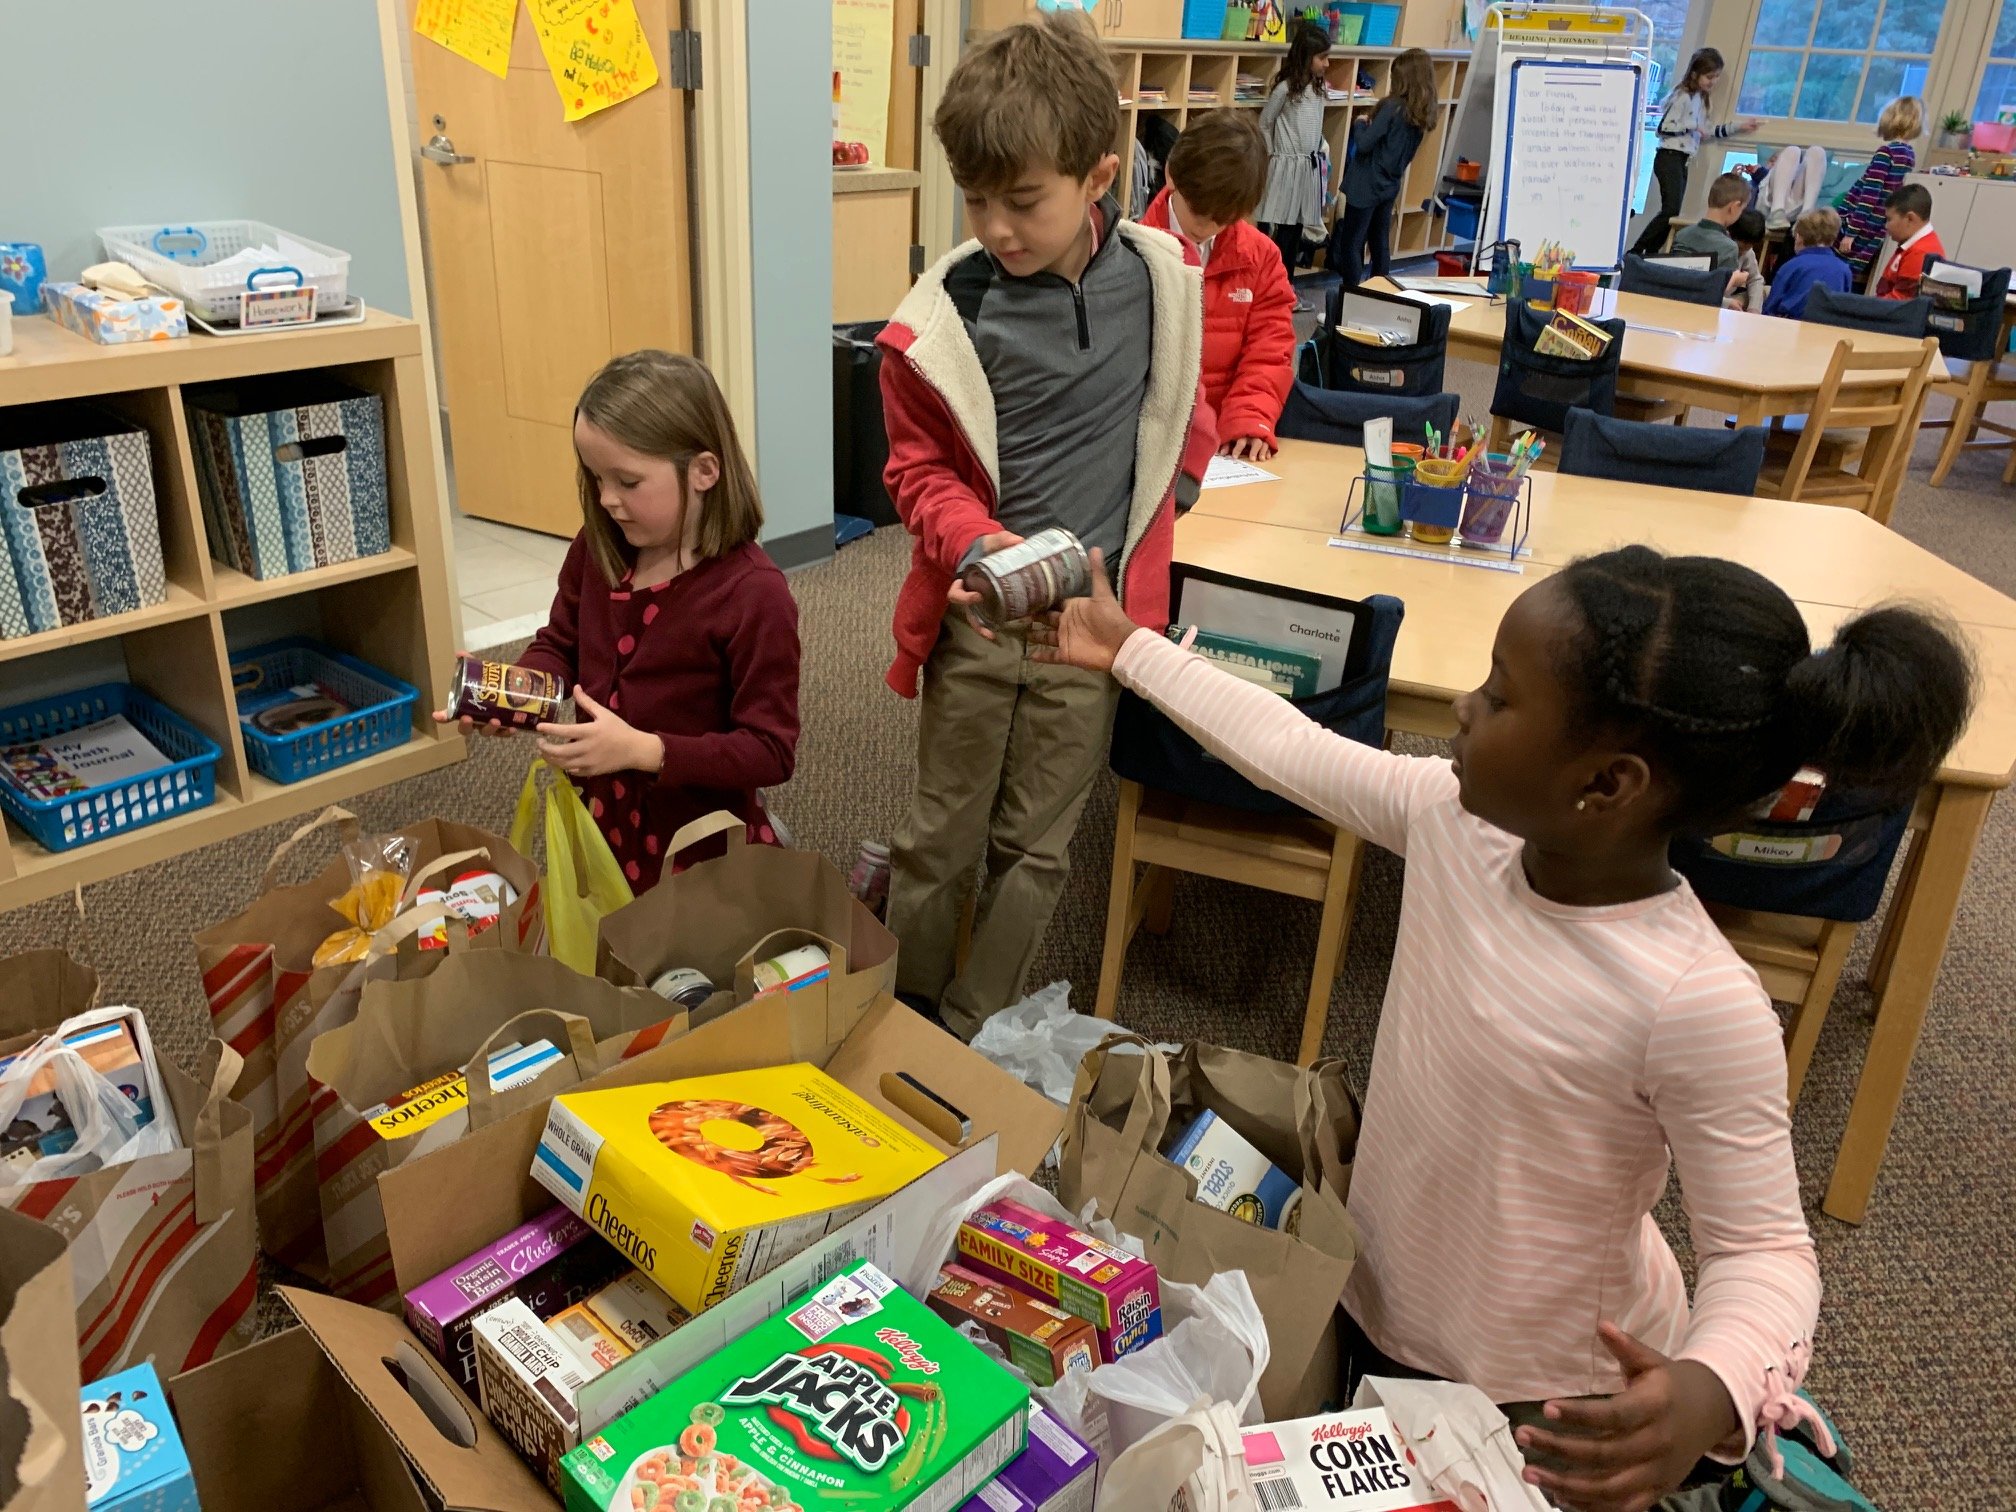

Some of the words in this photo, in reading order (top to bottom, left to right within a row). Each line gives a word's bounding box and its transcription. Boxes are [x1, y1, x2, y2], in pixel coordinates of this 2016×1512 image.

[1509, 34, 1546, 43] READING
[1558, 36, 1599, 45] THINKING
[252, 302, 305, 319] Homework
[1289, 623, 1341, 643] Charlotte
[53, 743, 81, 754] My
[62, 746, 110, 763] Math
[73, 748, 135, 770] Journal
[1754, 845, 1794, 857] Mikey
[402, 1071, 459, 1100] Cheerios
[548, 1119, 571, 1147] WHOLE
[570, 1140, 592, 1166] GRAIN
[1222, 1181, 1236, 1202] QUICK
[589, 1193, 657, 1272] Cheerios
[496, 1241, 519, 1257] TRADER
[510, 1220, 579, 1274] Clusters
[455, 1260, 495, 1286] Organic
[960, 1229, 1015, 1271] FAMILY
[1018, 1259, 1056, 1295] SIZE
[462, 1268, 501, 1293] Raisin
[473, 1278, 504, 1299] Bran
[859, 1269, 884, 1290] FROZEN
[808, 1304, 837, 1327] FREE
[1118, 1292, 1152, 1321] Raisin
[1123, 1306, 1150, 1332] Bran
[798, 1314, 823, 1335] INSIDE
[805, 1310, 829, 1331] TATTOO
[511, 1325, 541, 1351] CHOCOLATE
[536, 1348, 560, 1369] CHIP
[534, 1334, 558, 1356] ORGANIC
[876, 1328, 940, 1374] Kellogg's
[1114, 1322, 1148, 1355] Crunch
[499, 1332, 530, 1363] GRANOLA
[524, 1356, 546, 1377] BARS
[807, 1353, 896, 1417] APPLE
[485, 1372, 546, 1454] CHOCOLATE
[502, 1377, 556, 1440] ORGANIC
[728, 1355, 900, 1465] JACKS
[87, 1417, 97, 1437] Bars
[489, 1397, 538, 1457] CHIP
[1310, 1420, 1373, 1444] Kellogg's
[92, 1435, 108, 1467] Granola
[738, 1416, 769, 1447] APPLE
[766, 1445, 777, 1456] &
[779, 1454, 845, 1489] CINNAMON
[1309, 1433, 1398, 1473] CORN
[1320, 1462, 1412, 1500] FLAKES
